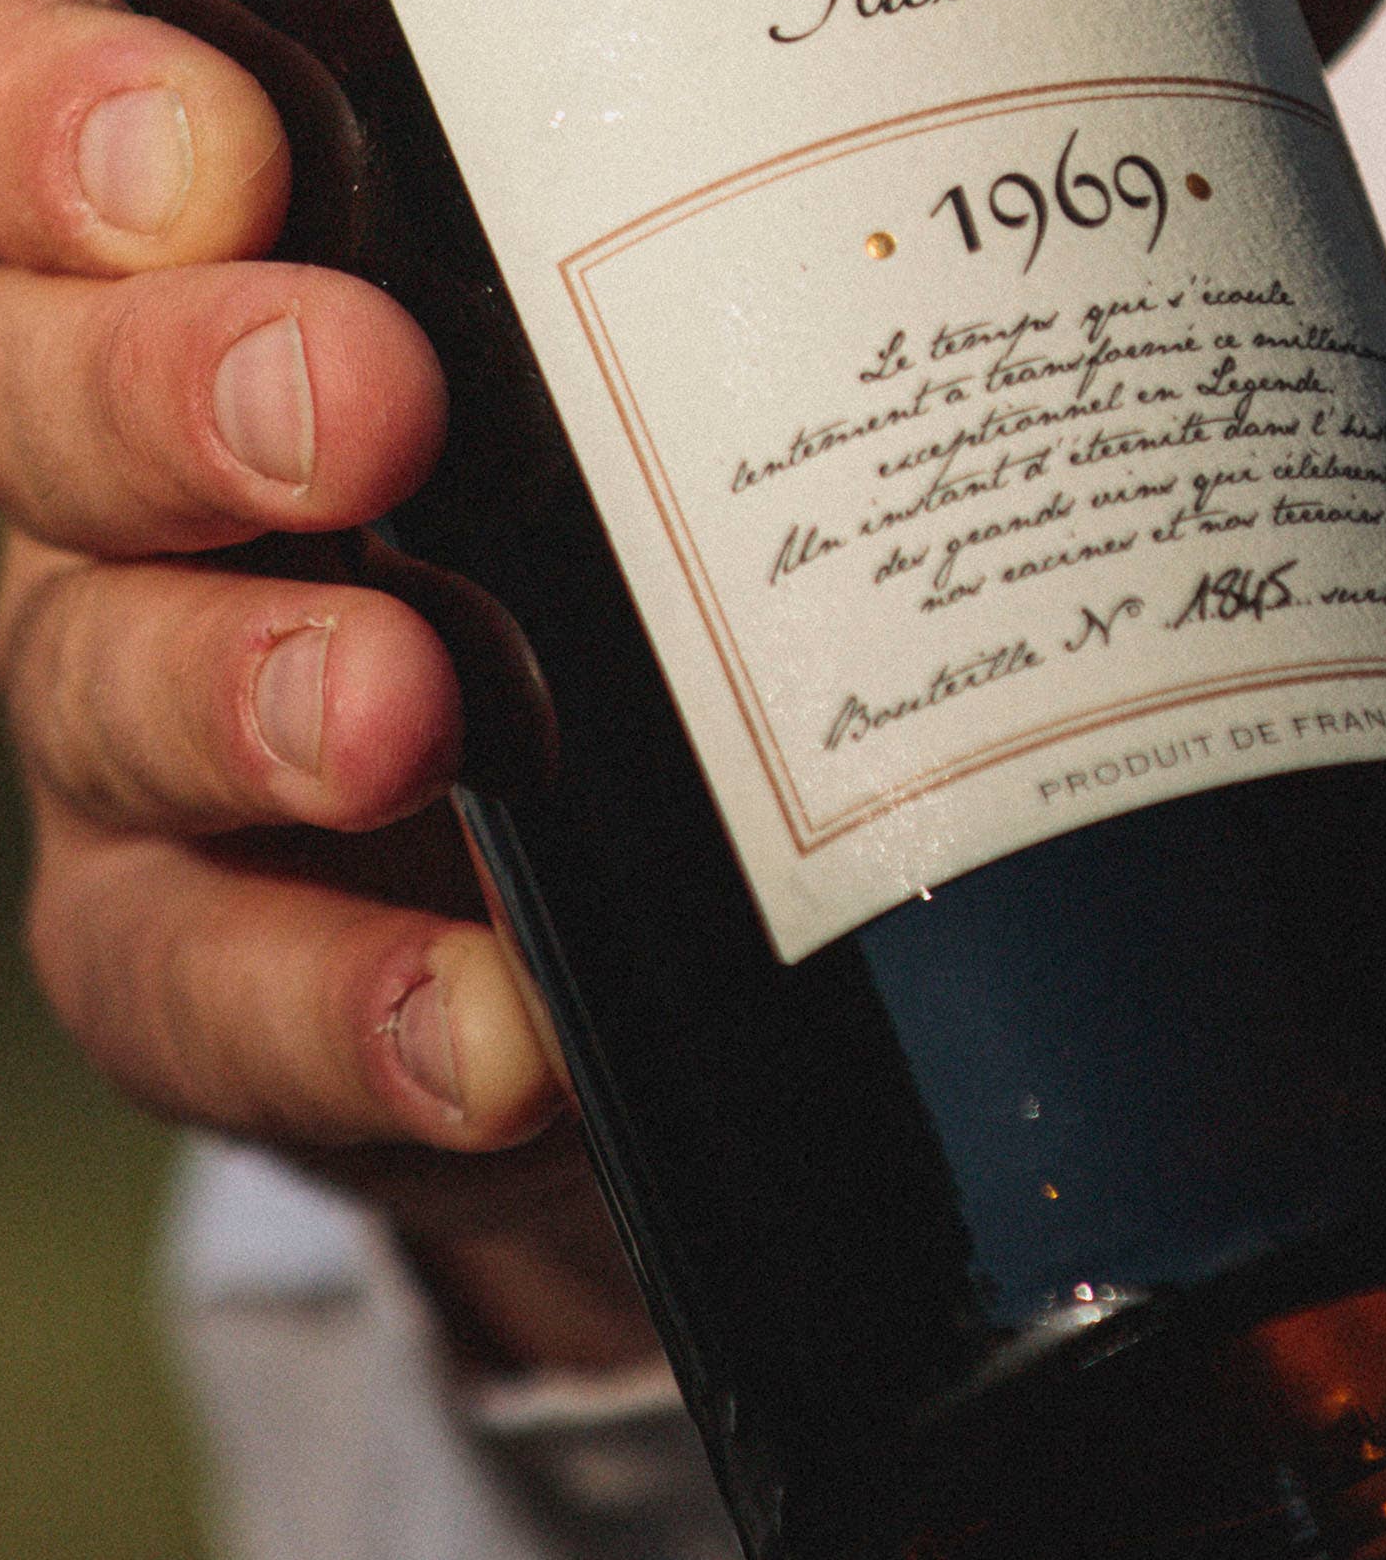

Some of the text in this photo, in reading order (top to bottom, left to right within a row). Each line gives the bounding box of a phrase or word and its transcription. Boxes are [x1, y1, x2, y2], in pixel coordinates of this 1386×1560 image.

[929, 127, 1169, 276] 1969
[859, 329, 916, 382] Le
[929, 310, 1060, 376] temps
[1080, 279, 1157, 343] qui
[730, 378, 958, 495] lentement
[1213, 332, 1245, 350] ce
[878, 380, 1124, 493] exceptionnel
[1136, 382, 1184, 402] en
[769, 524, 849, 586] Un
[860, 452, 1018, 537] instant
[1223, 414, 1302, 443] dans
[873, 545, 931, 585] des
[934, 490, 1076, 591] grands
[1091, 469, 1177, 510] vins
[1193, 451, 1262, 513] qui
[919, 576, 987, 614] nos
[999, 529, 1138, 584] racines
[1151, 507, 1208, 544] et
[1198, 511, 1259, 534] nos
[823, 638, 1046, 752] Bouteille
[1063, 595, 1145, 653] N°
[1038, 731, 1214, 806] PRODUIT
[1227, 721, 1282, 751] DE
